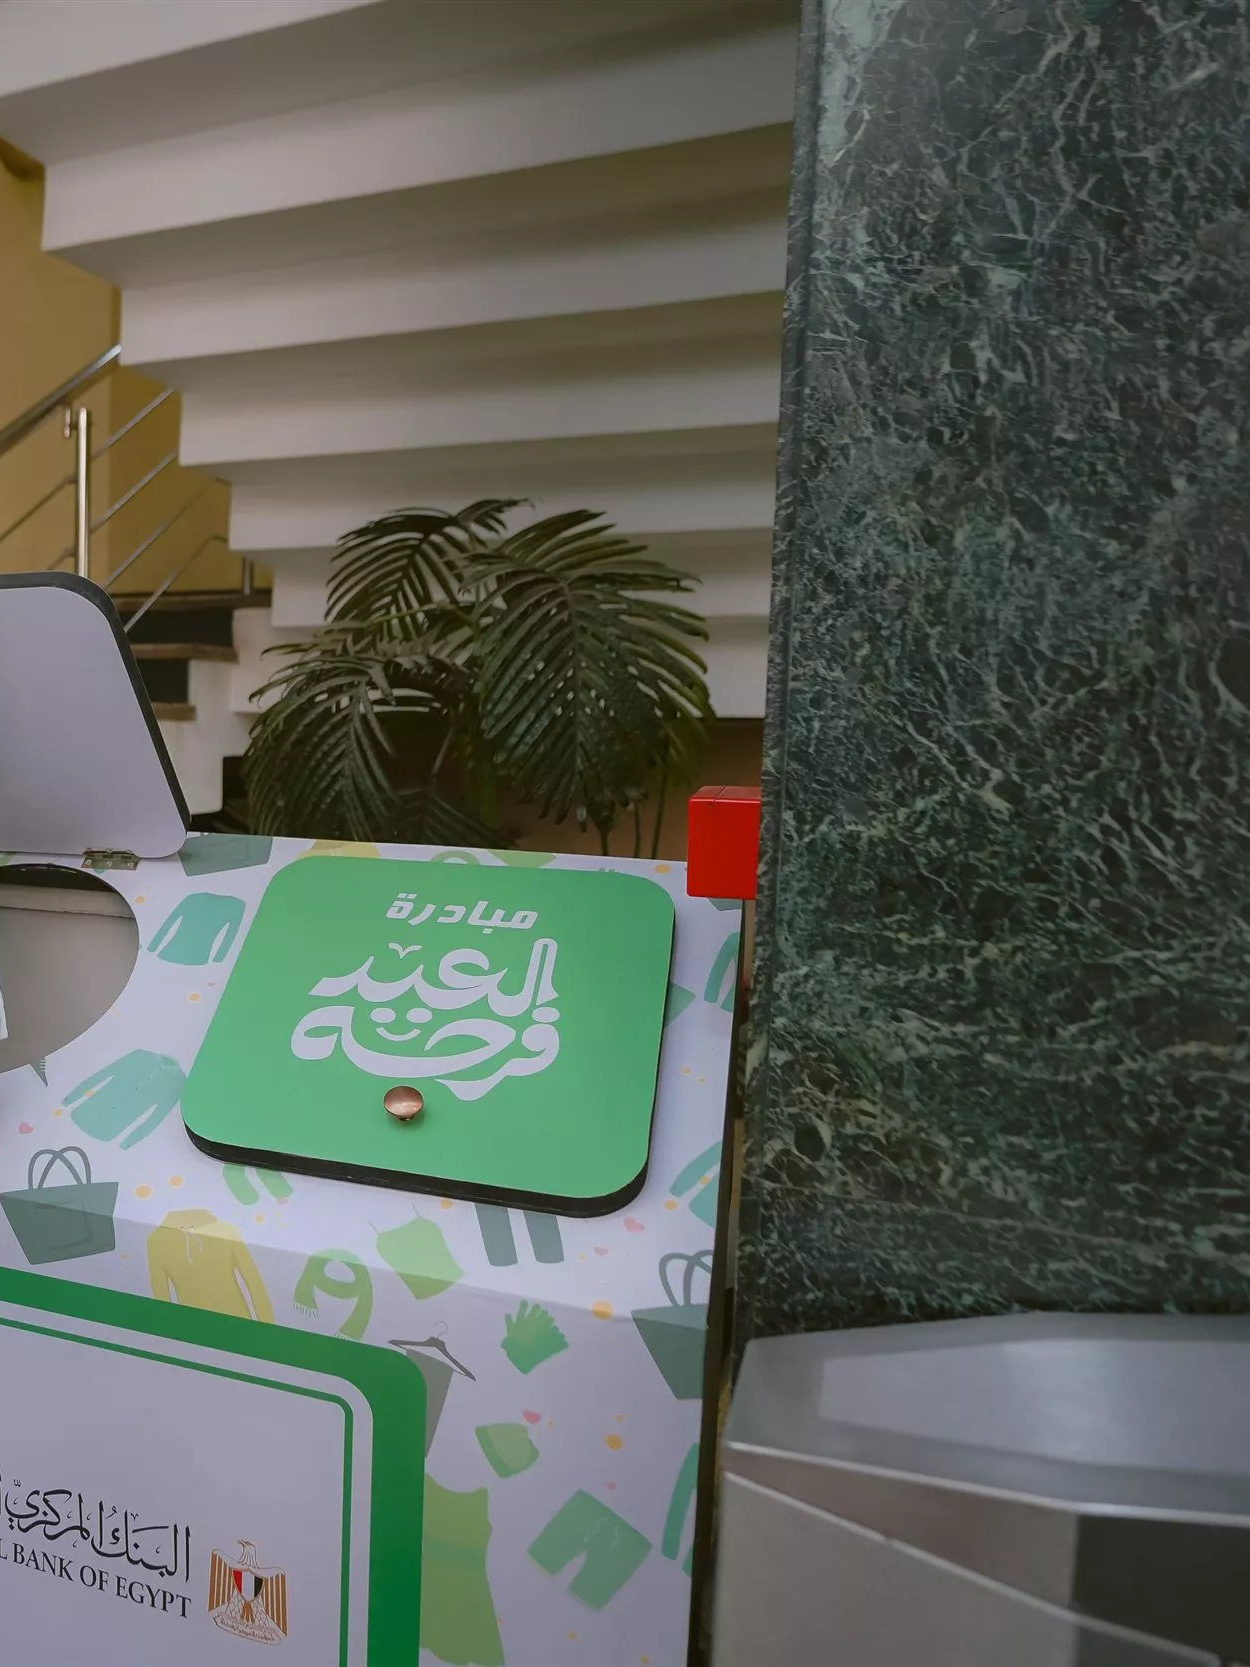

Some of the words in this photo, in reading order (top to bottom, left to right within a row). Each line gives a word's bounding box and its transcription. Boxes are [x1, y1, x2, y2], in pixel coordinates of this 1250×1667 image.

[385, 892, 539, 935] مبادرة
[307, 937, 560, 1018] العيد
[13, 1543, 74, 1582] BANK
[79, 1564, 110, 1593] OF
[115, 1574, 193, 1619] EGYPT
